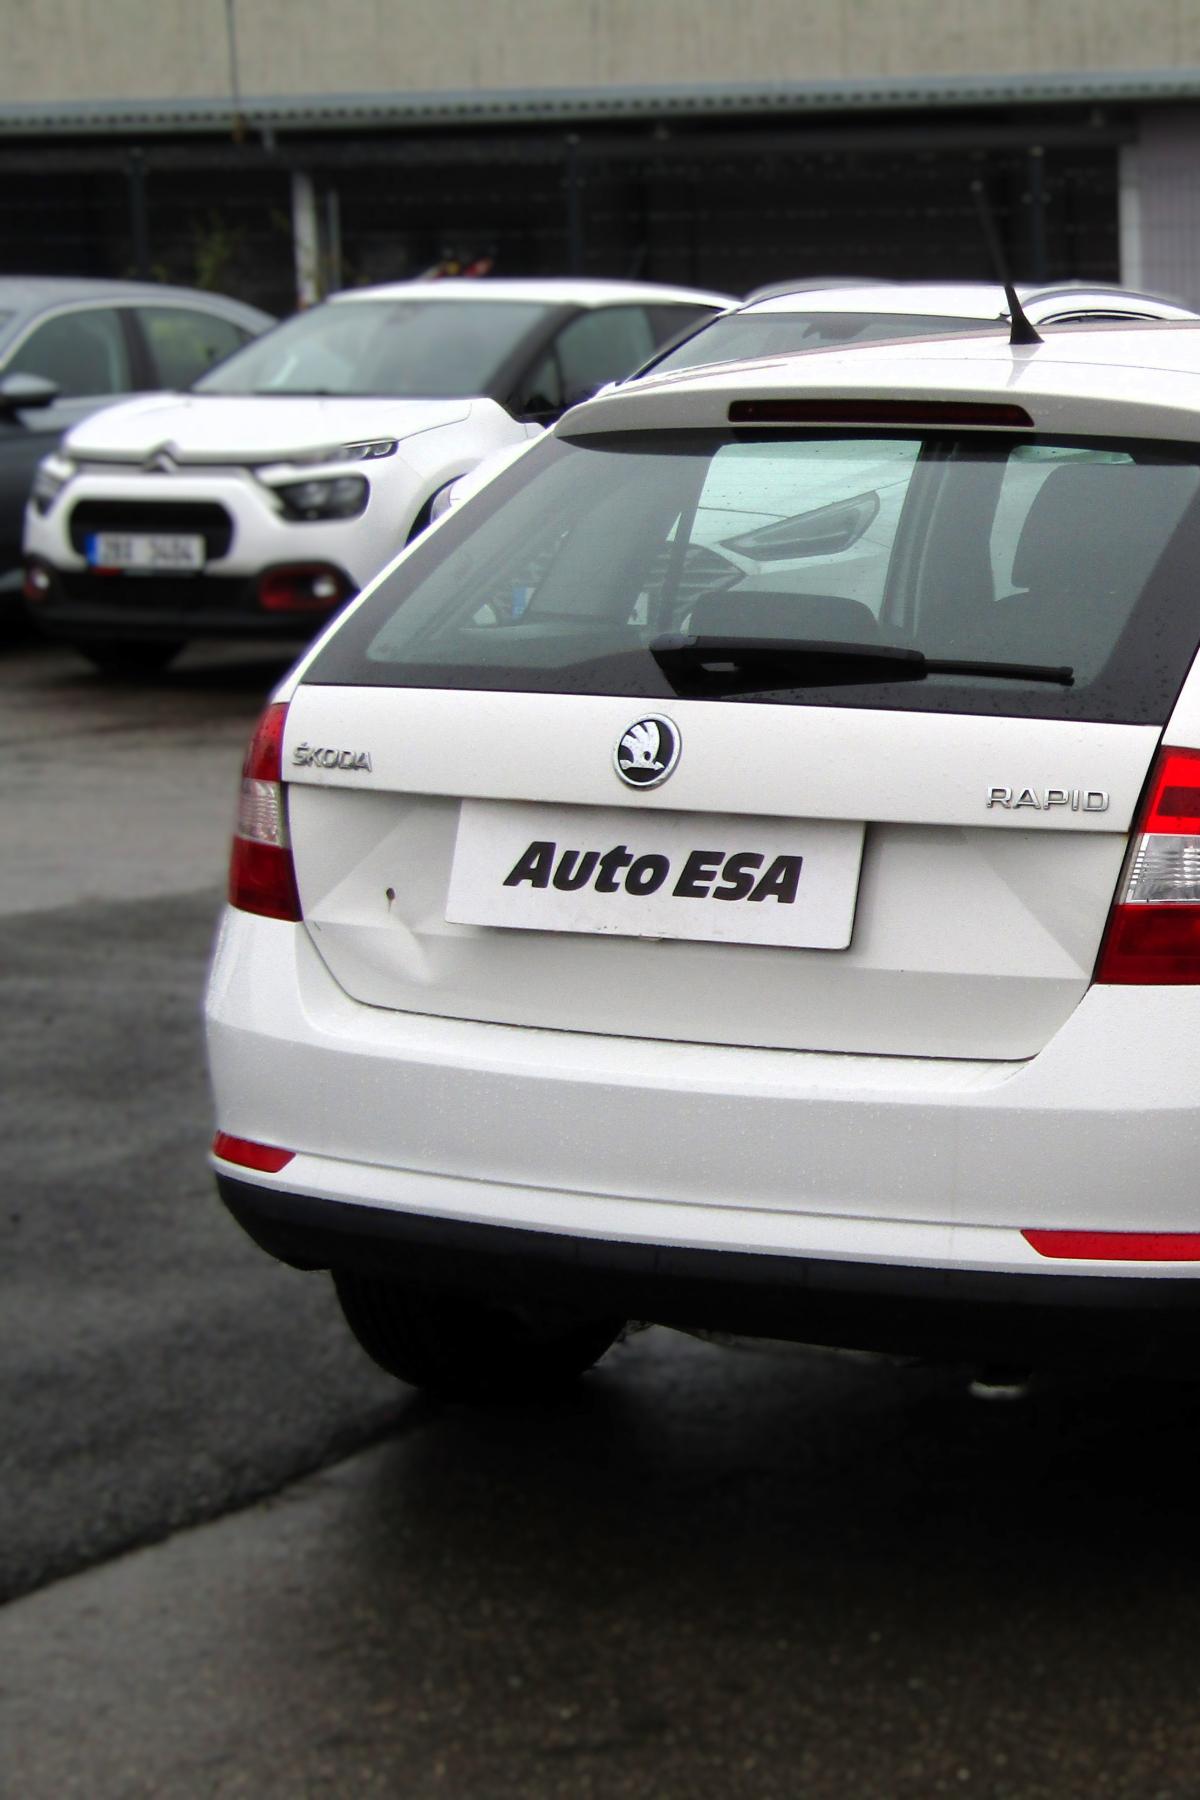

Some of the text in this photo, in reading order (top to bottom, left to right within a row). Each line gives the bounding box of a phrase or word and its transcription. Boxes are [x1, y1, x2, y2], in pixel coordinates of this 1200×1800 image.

[986, 786, 1110, 812] RAPID
[502, 840, 804, 904] Auto ESA
